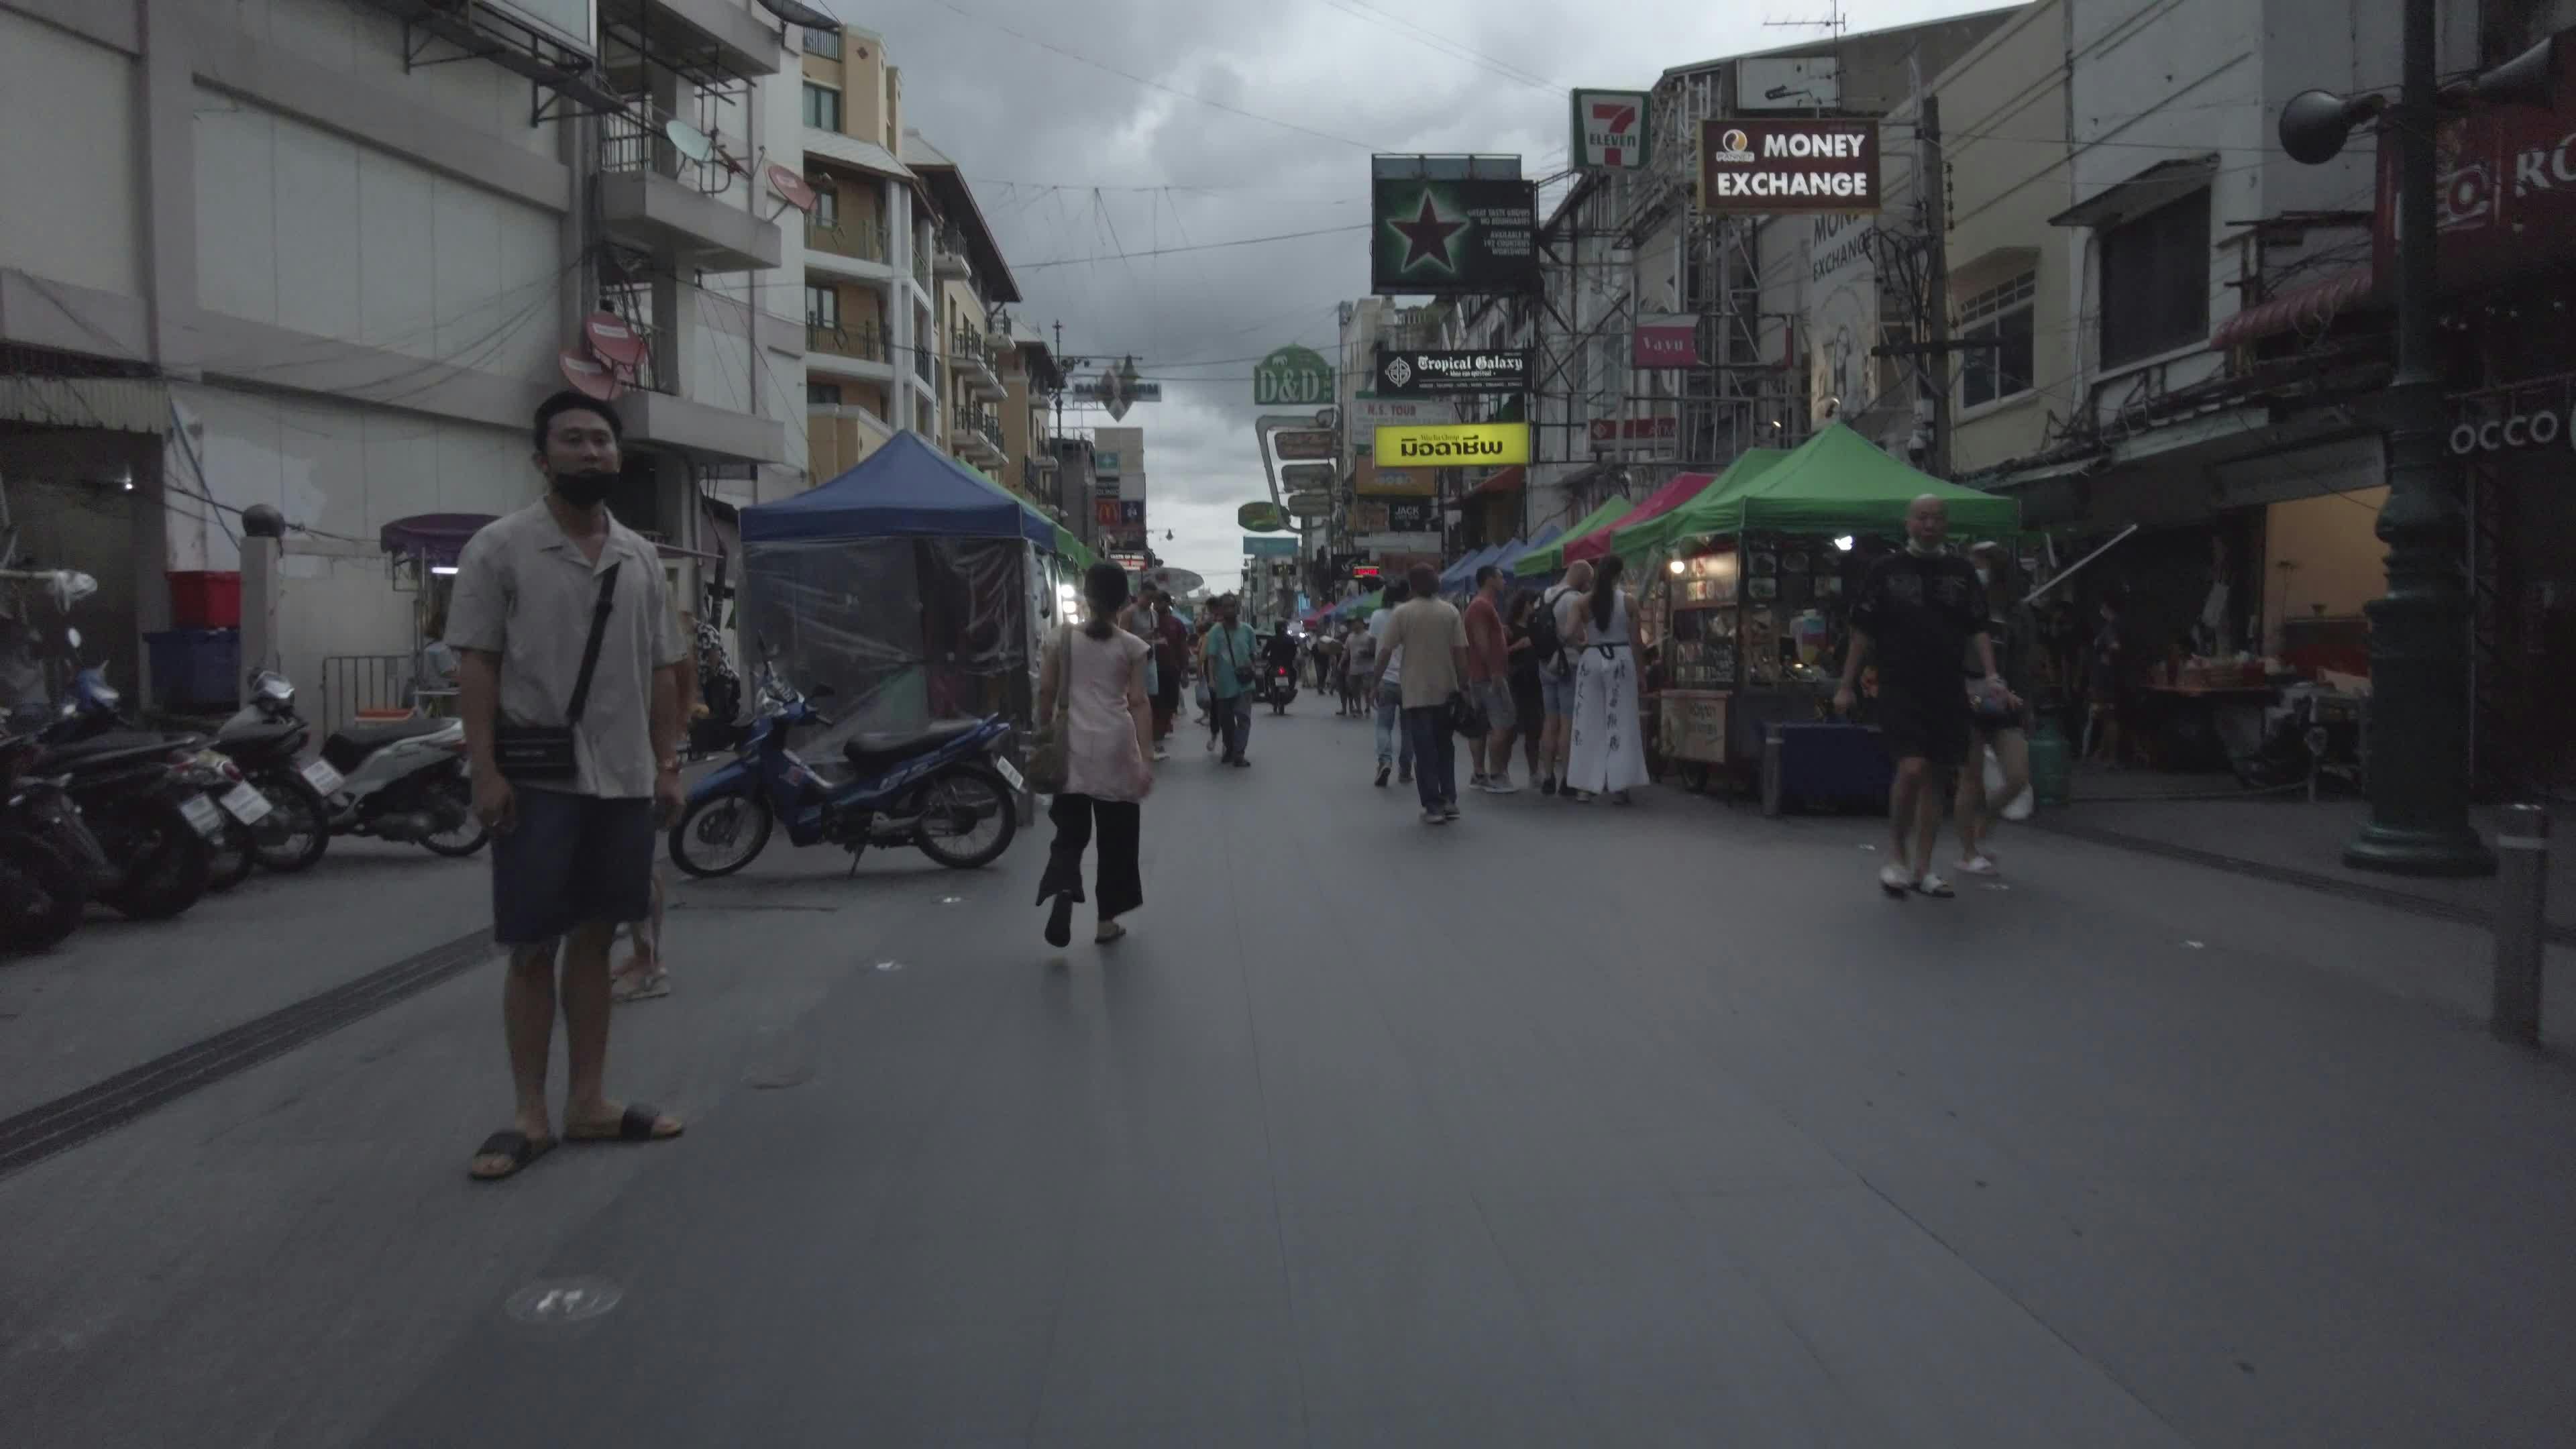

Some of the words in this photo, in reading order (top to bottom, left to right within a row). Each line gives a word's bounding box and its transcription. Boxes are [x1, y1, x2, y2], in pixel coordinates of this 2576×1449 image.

[1764, 133, 1865, 158] MONEY
[1717, 172, 1867, 196] EXCHANGE
[1417, 356, 1471, 372] Tropical
[1475, 355, 1523, 371] Galaxy
[1258, 369, 1320, 402] D&D
[2443, 410, 2558, 455] OCCO
[1395, 505, 1419, 516] JACK
